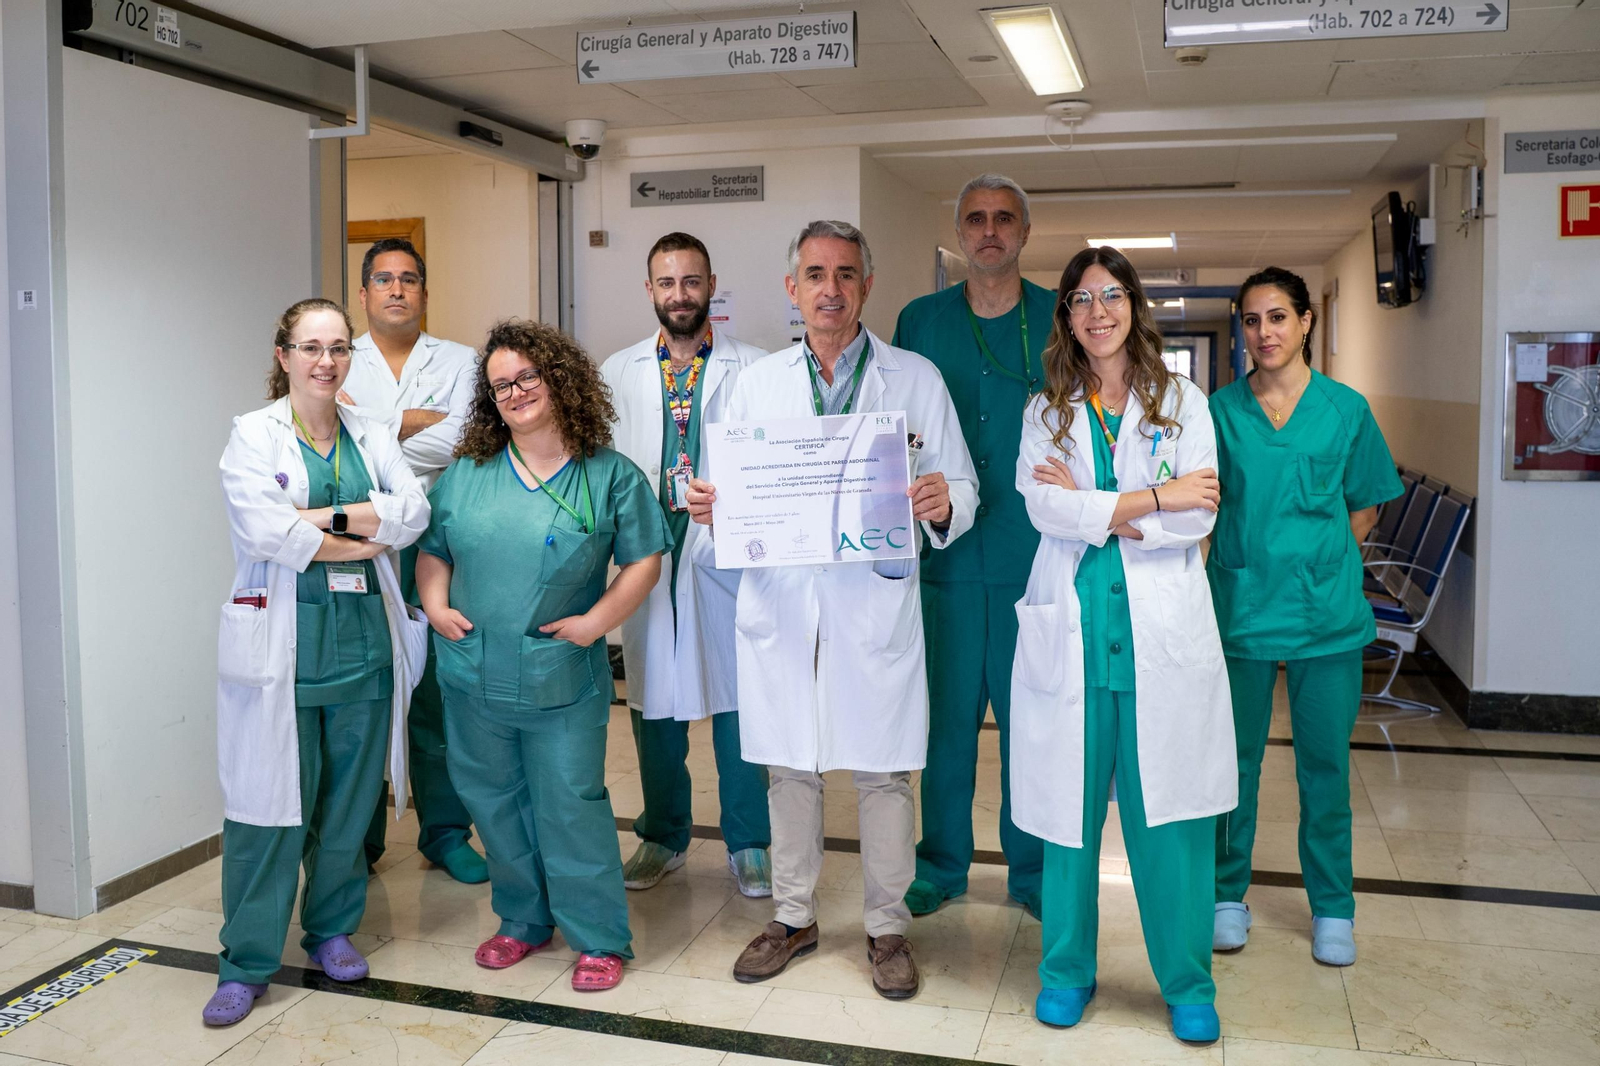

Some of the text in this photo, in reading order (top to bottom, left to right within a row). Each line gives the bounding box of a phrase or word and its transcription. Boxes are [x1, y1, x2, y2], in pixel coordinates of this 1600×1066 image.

[115, 0, 149, 32] 702
[1308, 6, 1454, 33] (Hab. 702 a 724)
[156, 26, 178, 44] HG 702
[580, 19, 848, 54] Cirugía General y Aparato Digestivo
[728, 42, 849, 68] (Hab. 728 a 747)
[1516, 136, 1600, 152] Secretaria Col
[1547, 152, 1600, 166] Esofago-
[712, 173, 758, 186] Secretaria
[658, 186, 758, 202] Hepatobiliar Endocrino
[876, 416, 892, 424] FCE
[726, 428, 748, 436] AEC
[836, 526, 907, 552] AEC
[0, 951, 141, 1031] CIA DE SEGURIDAD!
